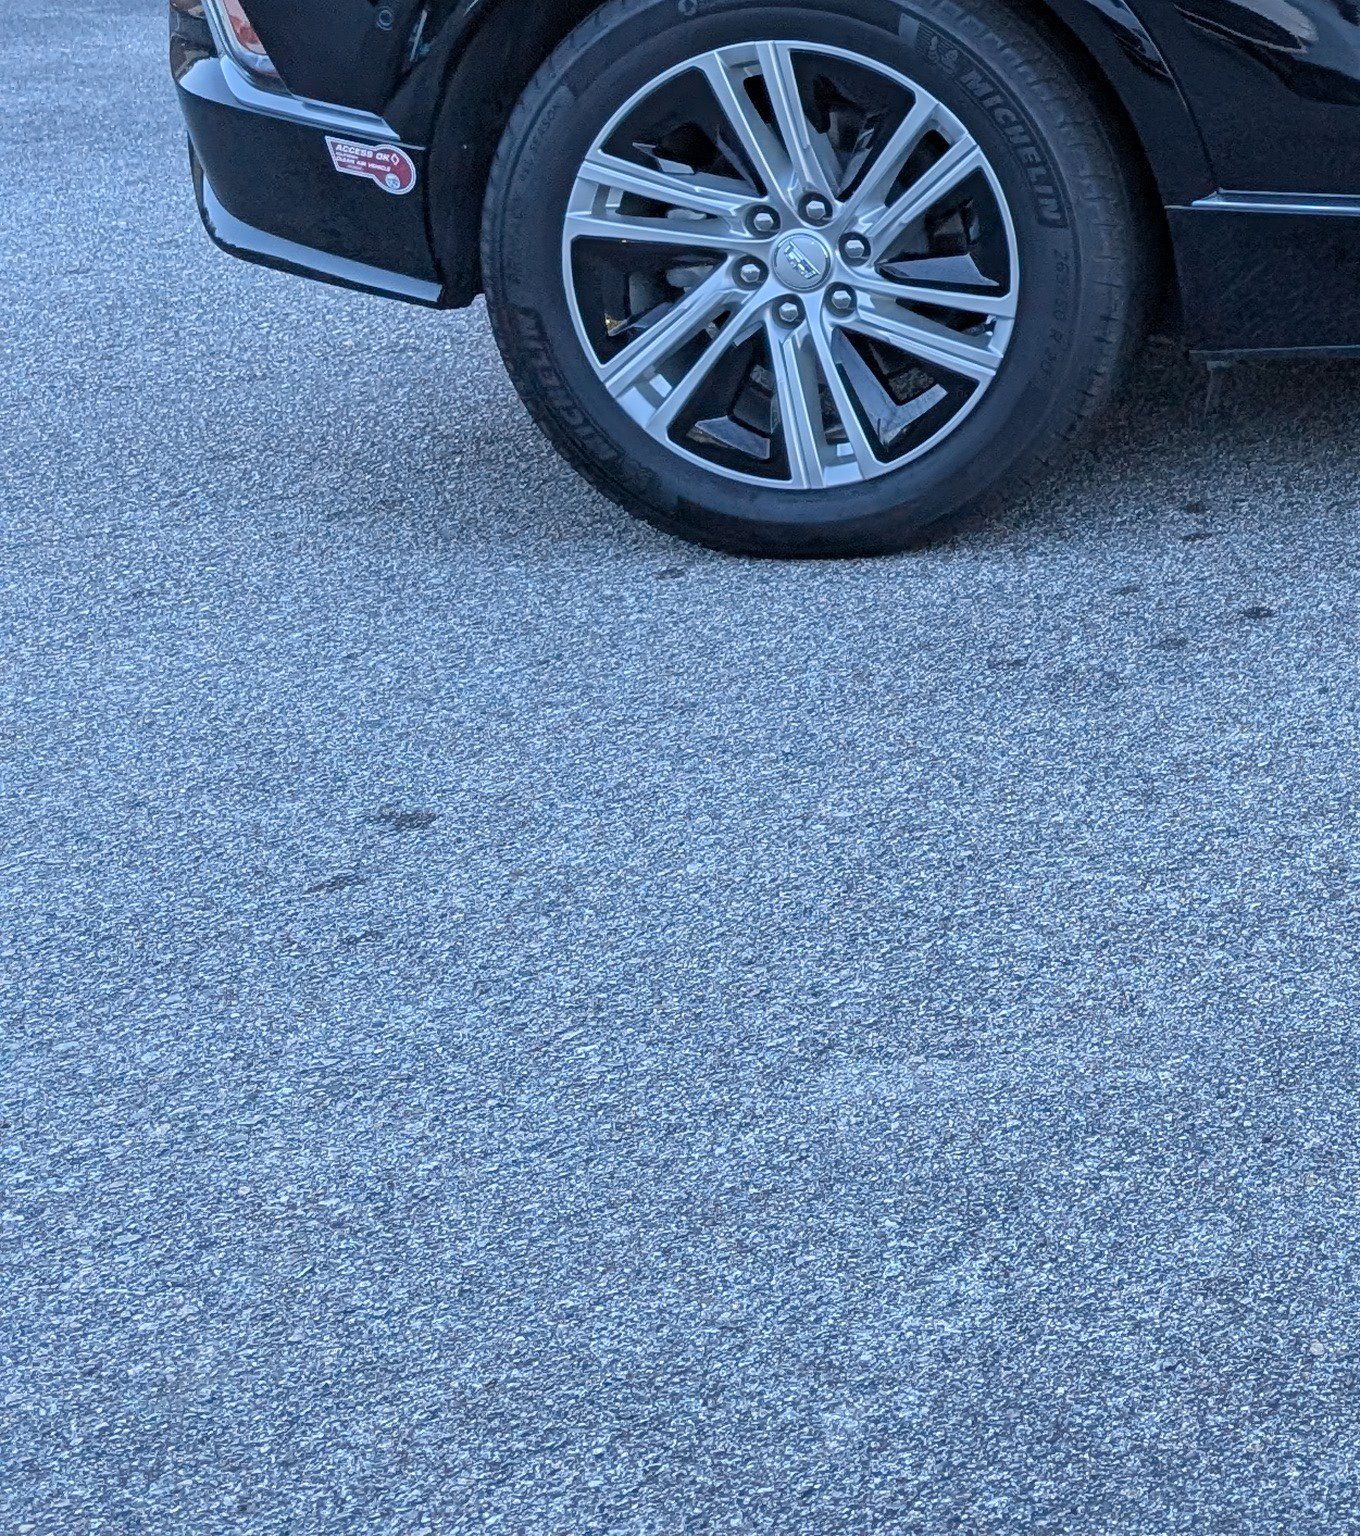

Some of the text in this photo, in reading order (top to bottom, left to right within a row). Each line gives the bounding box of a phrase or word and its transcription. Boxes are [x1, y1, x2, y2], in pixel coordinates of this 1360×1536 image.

[336, 144, 373, 158] ACCESS
[375, 152, 390, 162] OK
[960, 68, 1062, 221] MICHELIN
[519, 310, 620, 462] MICHELIN
